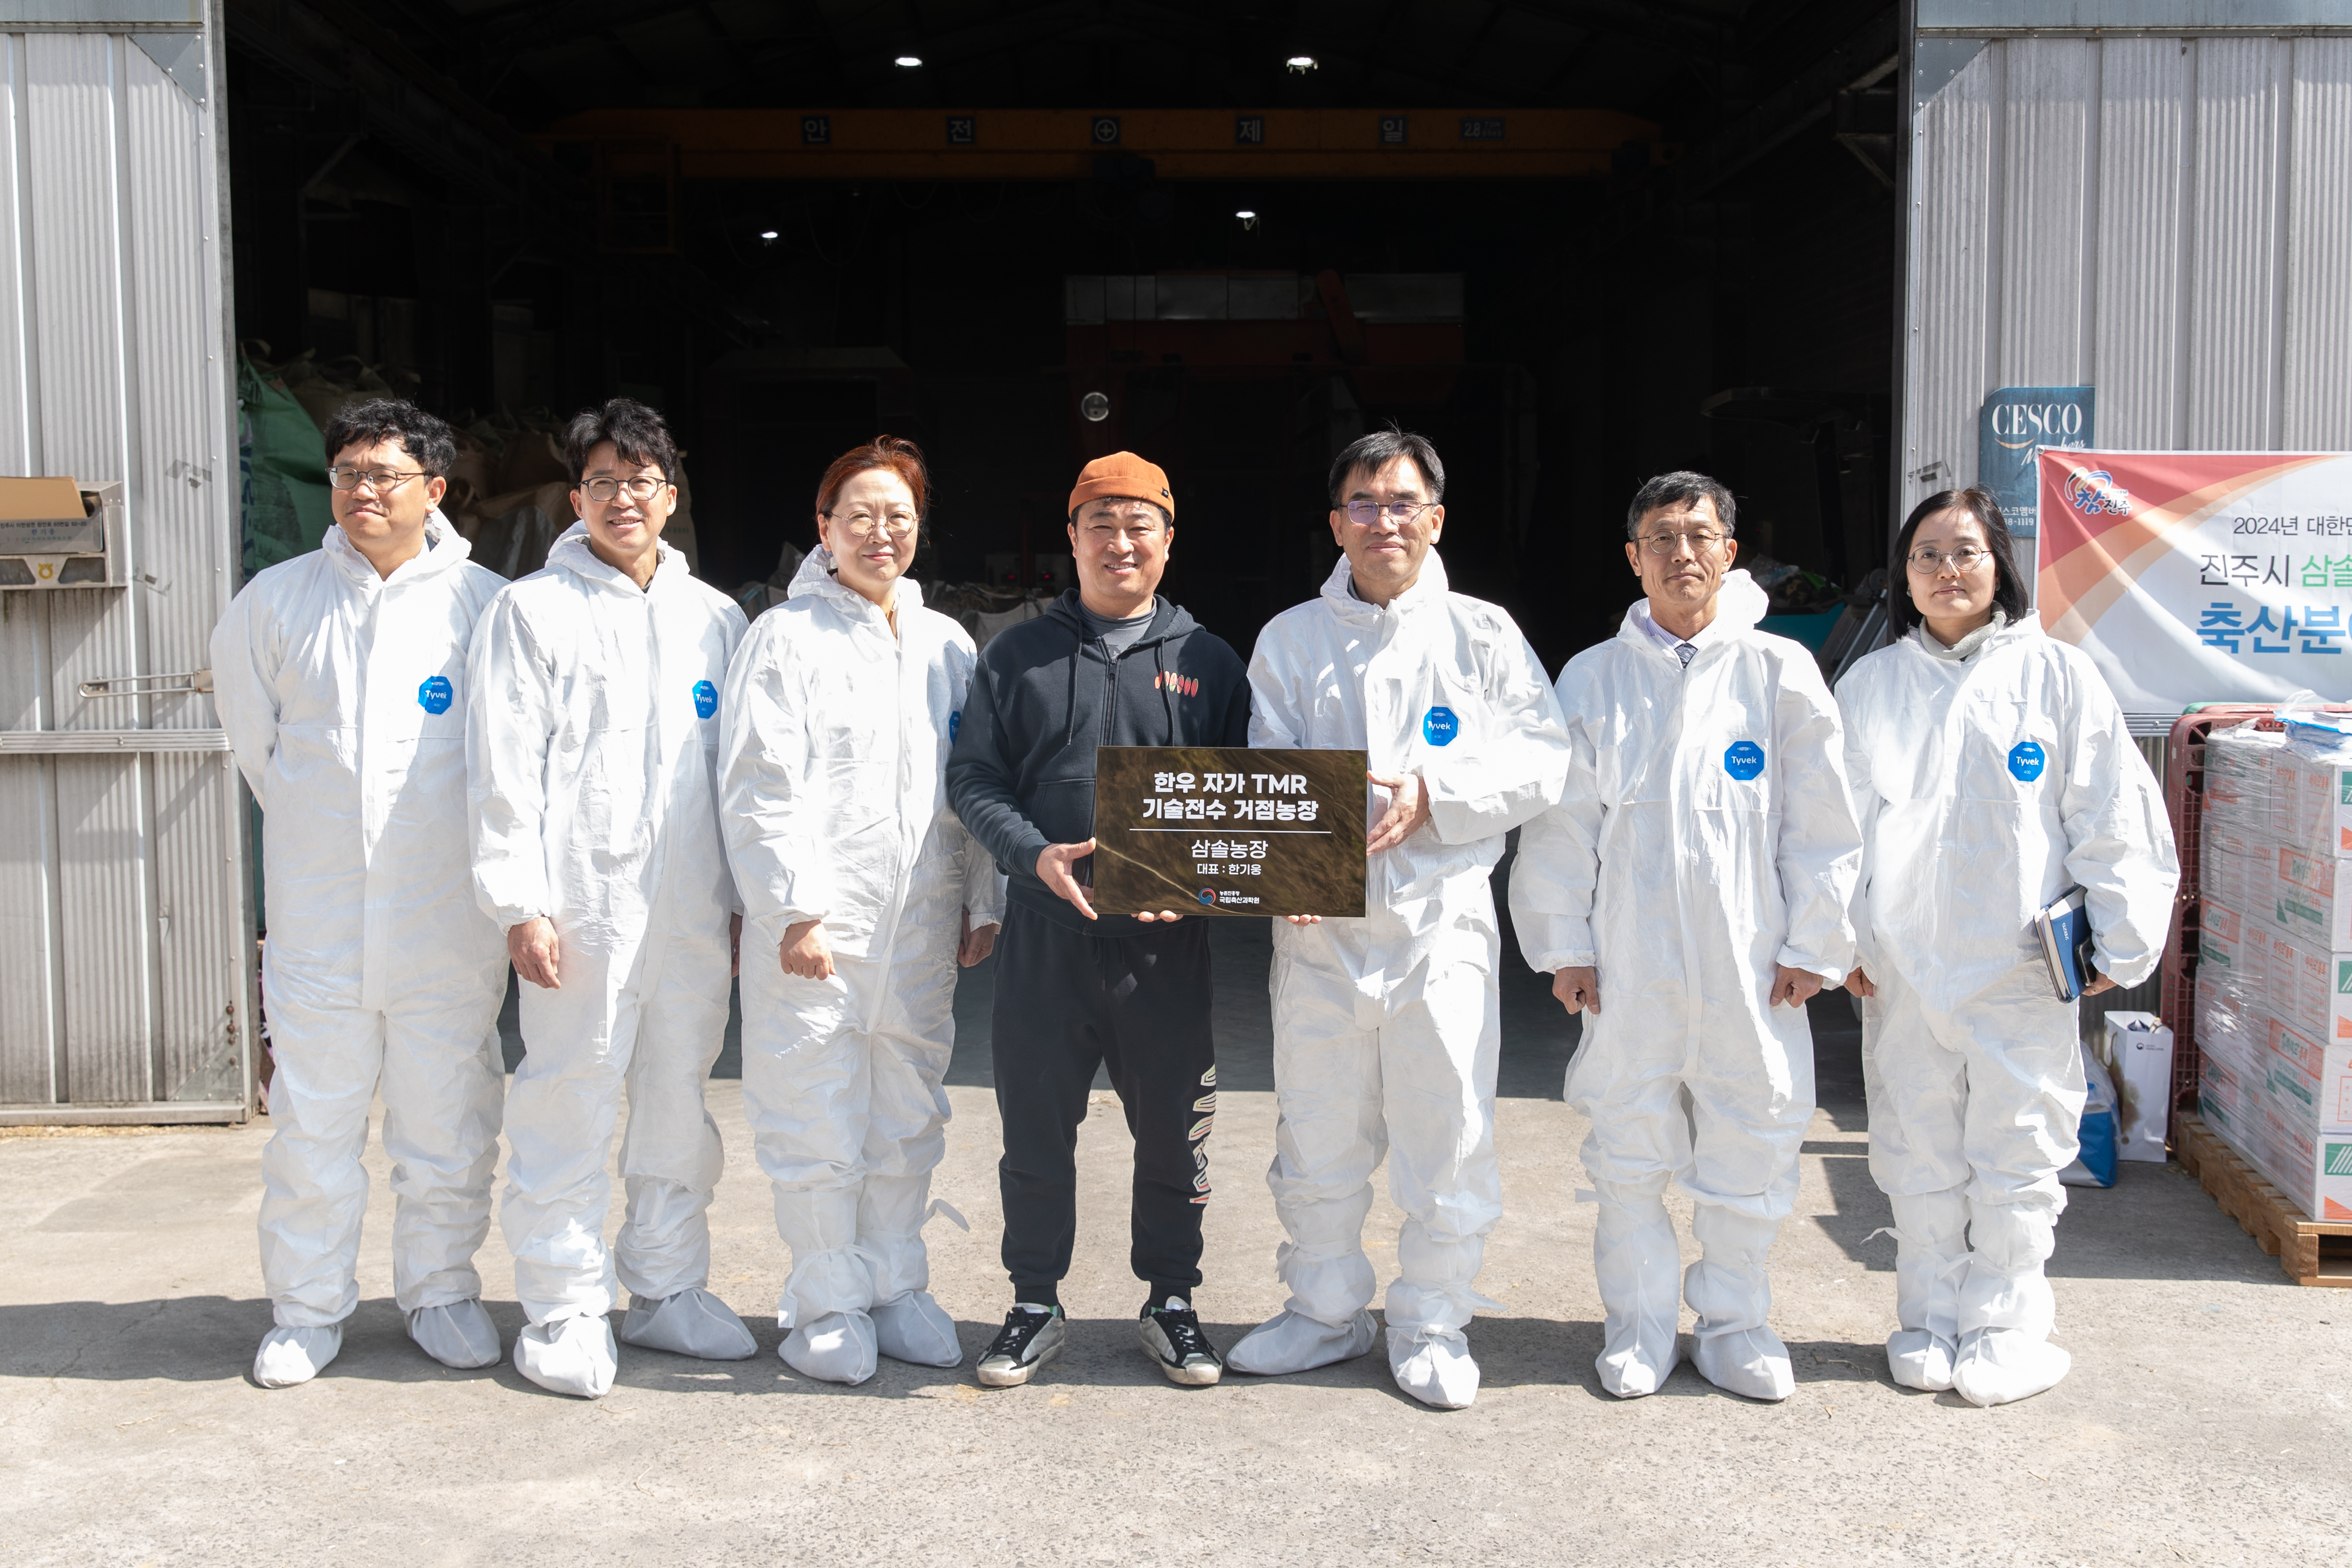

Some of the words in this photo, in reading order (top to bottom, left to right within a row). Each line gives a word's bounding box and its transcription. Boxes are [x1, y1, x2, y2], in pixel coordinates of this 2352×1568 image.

[804, 120, 827, 142] 안
[951, 120, 972, 142] 전
[1239, 120, 1260, 142] 제
[1383, 120, 1403, 142] 일
[1992, 403, 2083, 435] CESCO
[2074, 488, 2106, 514] 참
[2103, 500, 2131, 515] 진주
[2233, 515, 2298, 536] 2024년
[2200, 554, 2289, 587] 진주시
[2196, 602, 2352, 655] 축산분
[425, 690, 447, 700] Tyvek
[695, 694, 713, 704] Tyvek
[1427, 720, 1451, 731] Tyvek
[1731, 756, 1757, 766] Tyvek
[2016, 756, 2039, 766] Tyvek
[1154, 772, 1196, 793] 한우
[1203, 773, 1246, 794] 자가
[1251, 774, 1307, 795] TMR
[1142, 798, 1227, 820] 기술전수
[1233, 799, 1319, 821] 거점농장
[1191, 839, 1268, 859] 삼솔농장
[1197, 863, 1219, 875] 대표
[1228, 863, 1262, 875] 한기웅
